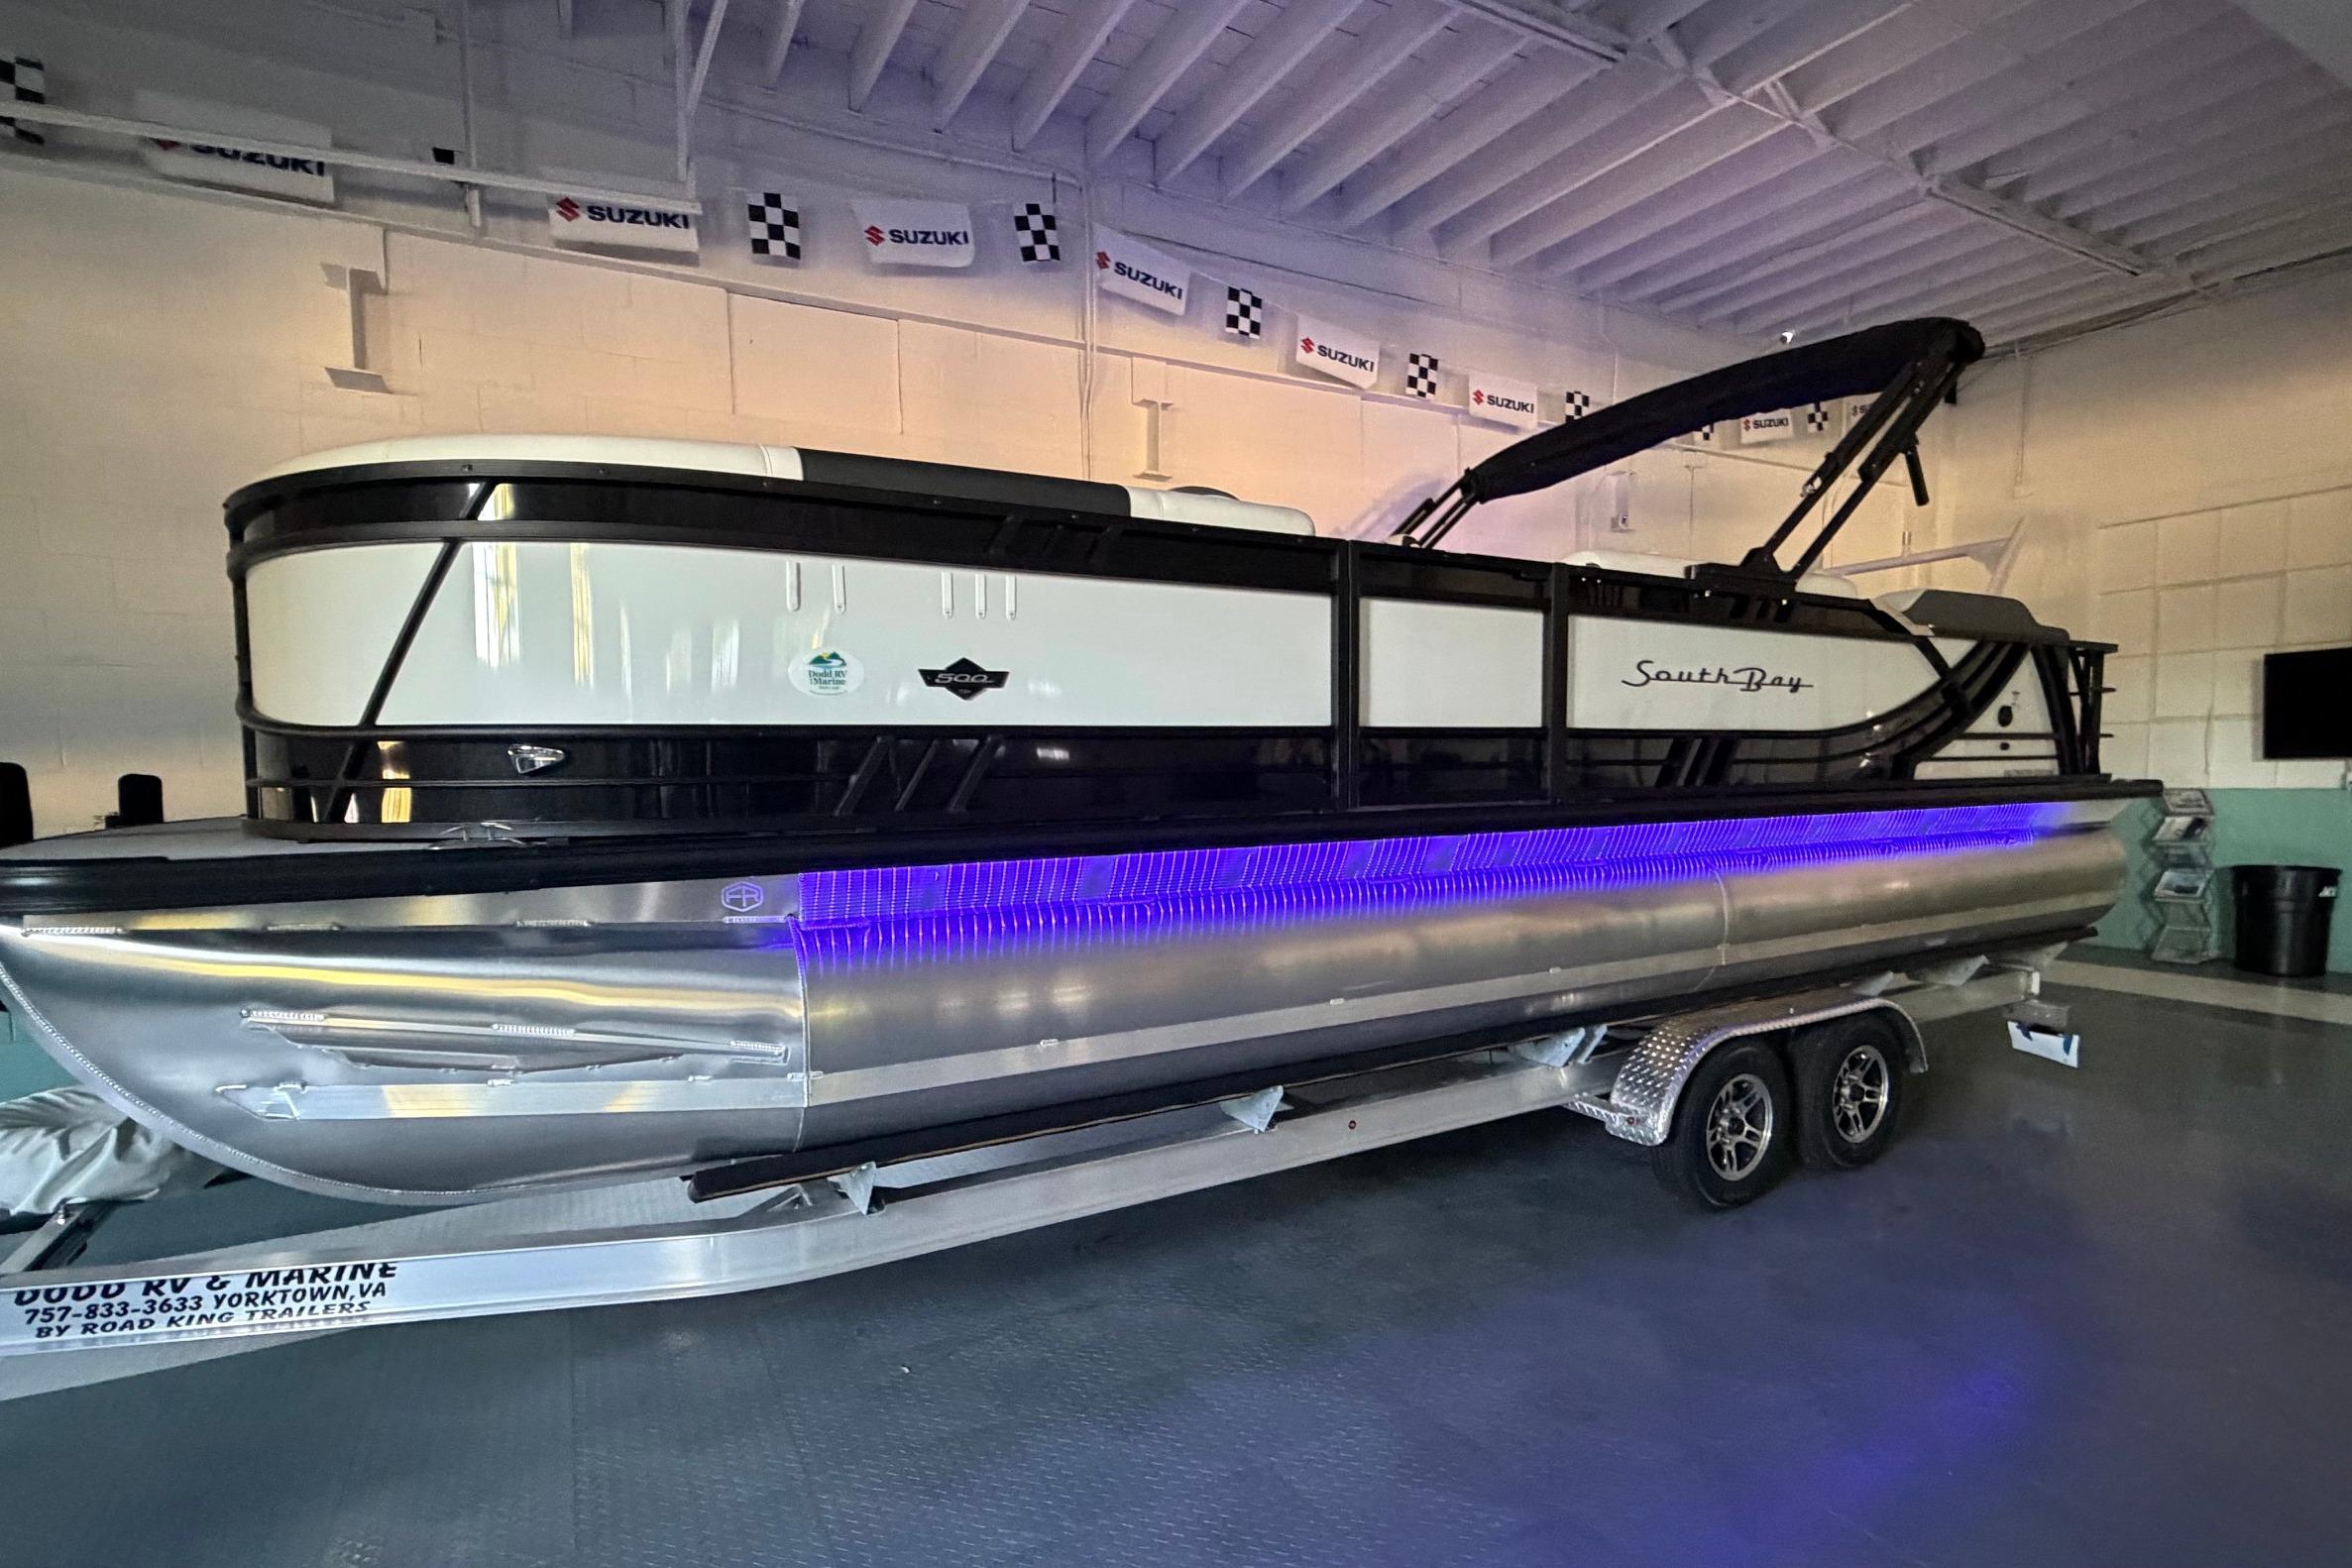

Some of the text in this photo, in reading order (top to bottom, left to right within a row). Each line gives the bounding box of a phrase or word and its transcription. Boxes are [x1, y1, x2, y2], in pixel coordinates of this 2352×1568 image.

[587, 204, 690, 230] SUZUKI
[888, 229, 969, 246] SUZUKI
[1113, 261, 1183, 300] SUZUKI
[1317, 344, 1375, 373] SUZUKI
[1487, 394, 1534, 414] SUZUKI
[1752, 417, 1790, 430] SUZUKI
[808, 669, 833, 678] Dodd
[813, 677, 846, 686] Marine
[1622, 659, 1815, 694] South Bay
[142, 1277, 191, 1297] RV
[245, 1261, 397, 1289] MARINE
[24, 1295, 203, 1325] 757-833-3633
[36, 1300, 372, 1339] BY ROAD KING TRAILERS
